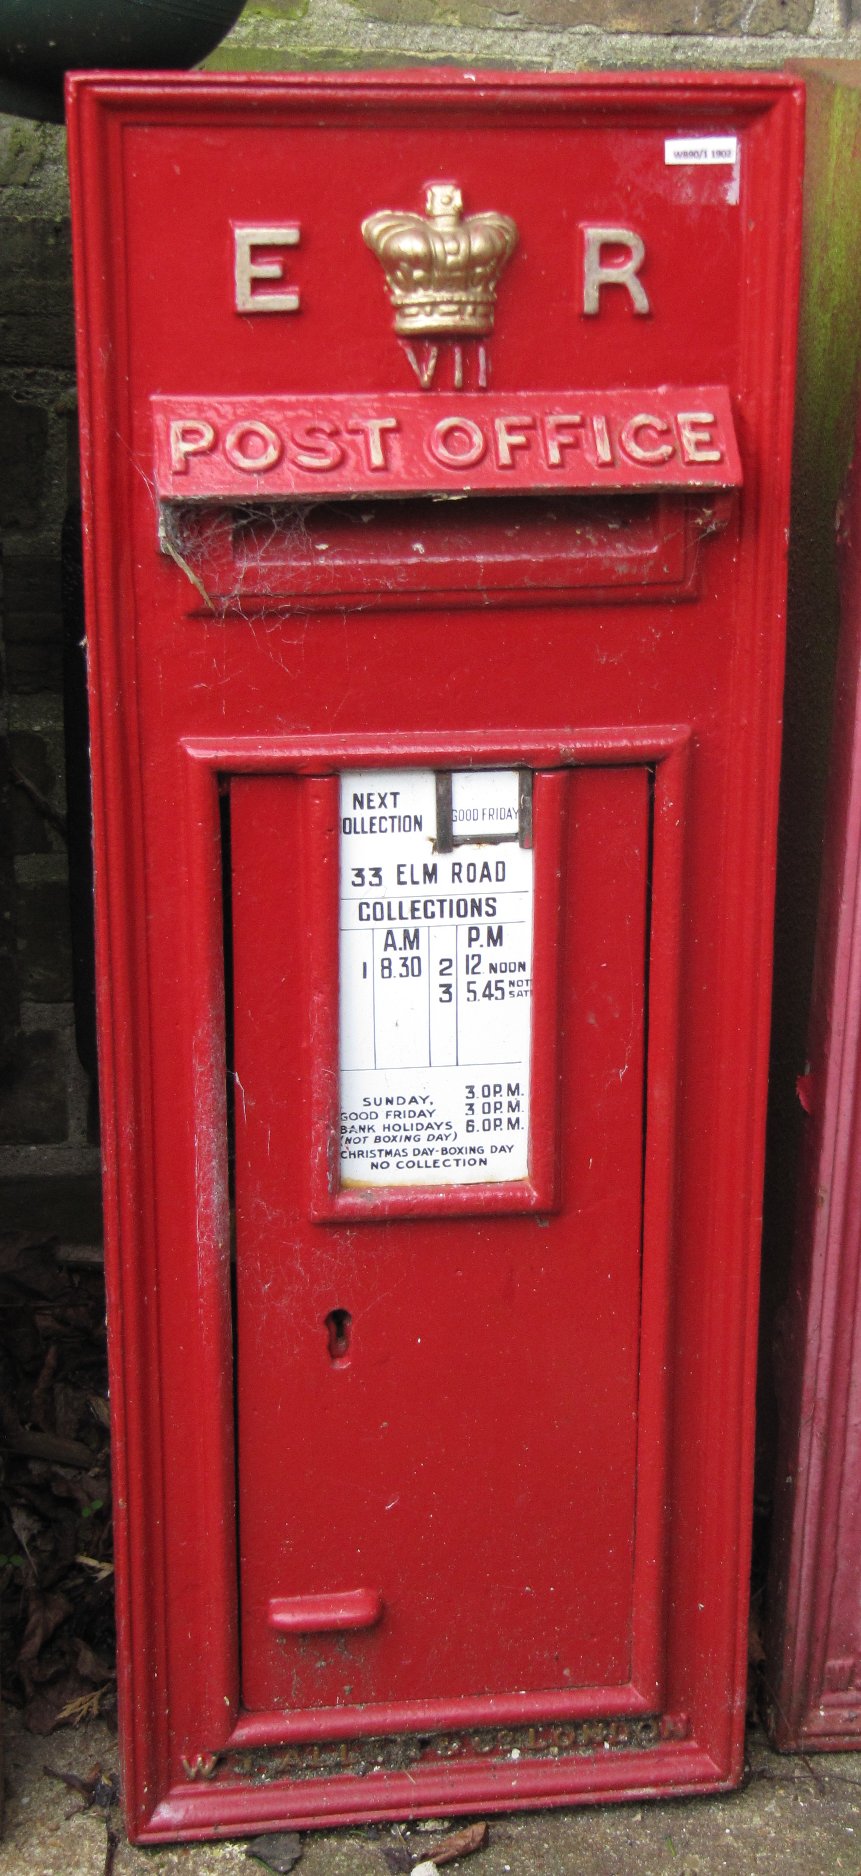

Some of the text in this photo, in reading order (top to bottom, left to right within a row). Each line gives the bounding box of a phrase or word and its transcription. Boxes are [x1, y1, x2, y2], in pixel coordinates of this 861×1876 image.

[233, 224, 652, 316] E R
[402, 345, 488, 389] VII
[168, 411, 722, 474] POST OFFICE
[352, 792, 401, 810] NEXT
[340, 814, 424, 835] OLLECTION
[452, 806, 520, 823] GOOD FRIDAY
[351, 860, 506, 887] 33 ELM ROAD
[358, 896, 498, 922] COLLECTIONS
[383, 928, 420, 952] A.M
[467, 924, 504, 949] P.M
[380, 956, 422, 979] 8.30
[438, 958, 454, 977] 2
[488, 960, 527, 975] NOON
[438, 979, 506, 1003] 3 5.45
[508, 979, 532, 988] NOT
[362, 1095, 434, 1107] SUNDAY,
[340, 1111, 379, 1121] GOOD
[385, 1109, 437, 1120] FRIDAY
[340, 1124, 377, 1135] BANK
[382, 1121, 454, 1133] HOLIDAYS
[373, 1134, 421, 1144] BOXING
[426, 1131, 459, 1143] DAY)
[340, 1148, 409, 1160] CHRISTMAS
[489, 1144, 515, 1154] DAY
[370, 1157, 489, 1171] NO COLLECTION
